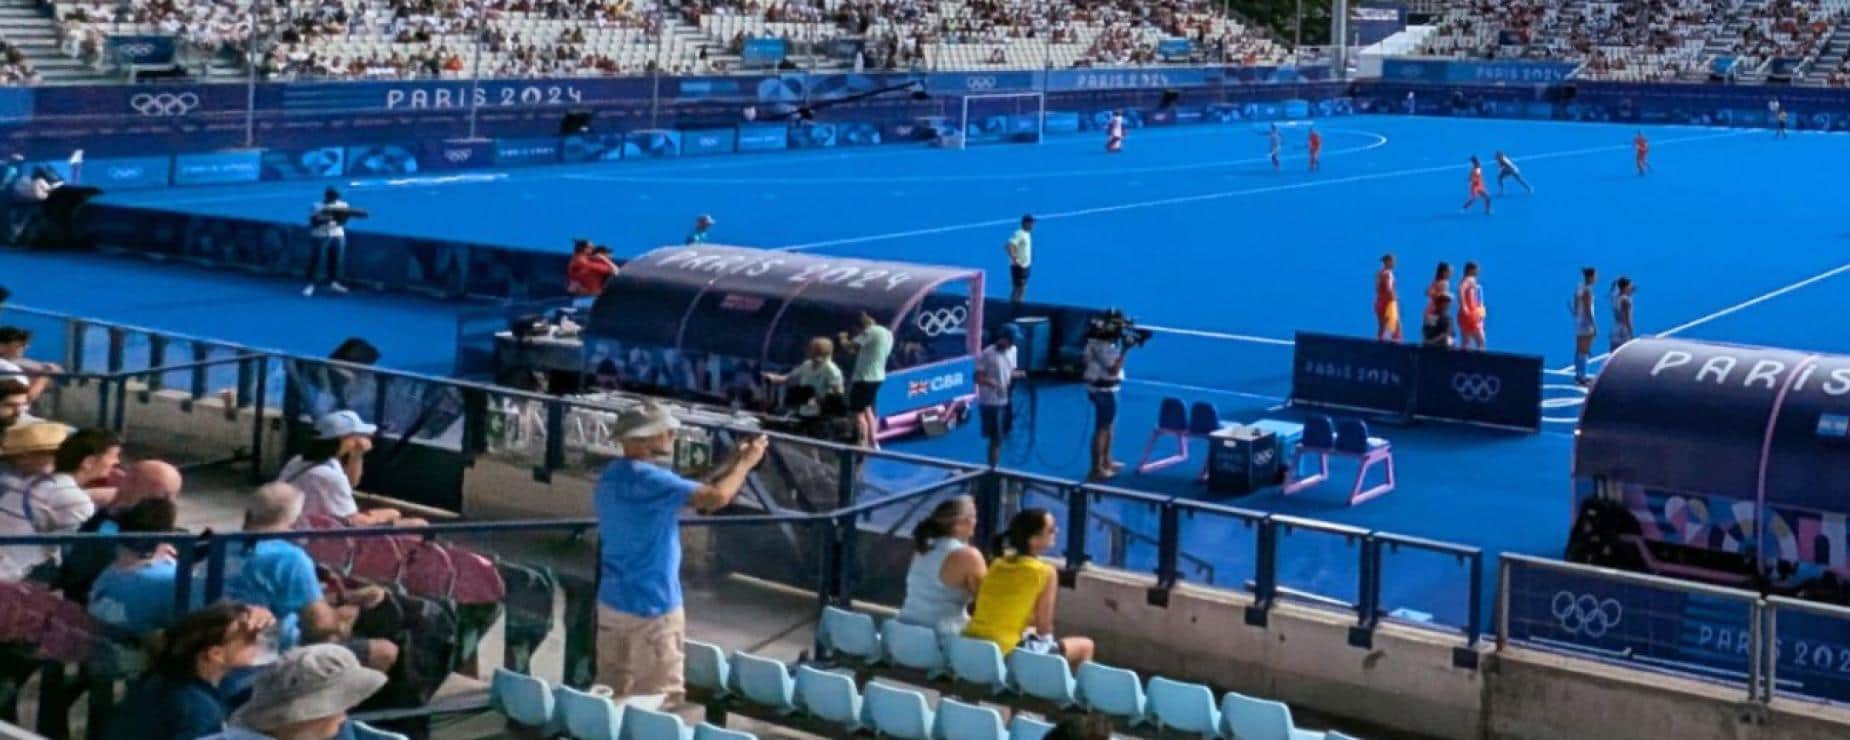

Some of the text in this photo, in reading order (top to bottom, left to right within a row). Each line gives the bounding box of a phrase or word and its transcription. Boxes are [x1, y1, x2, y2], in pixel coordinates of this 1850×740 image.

[387, 86, 581, 109] PARIS 2024
[656, 250, 912, 291] PARIS 2024
